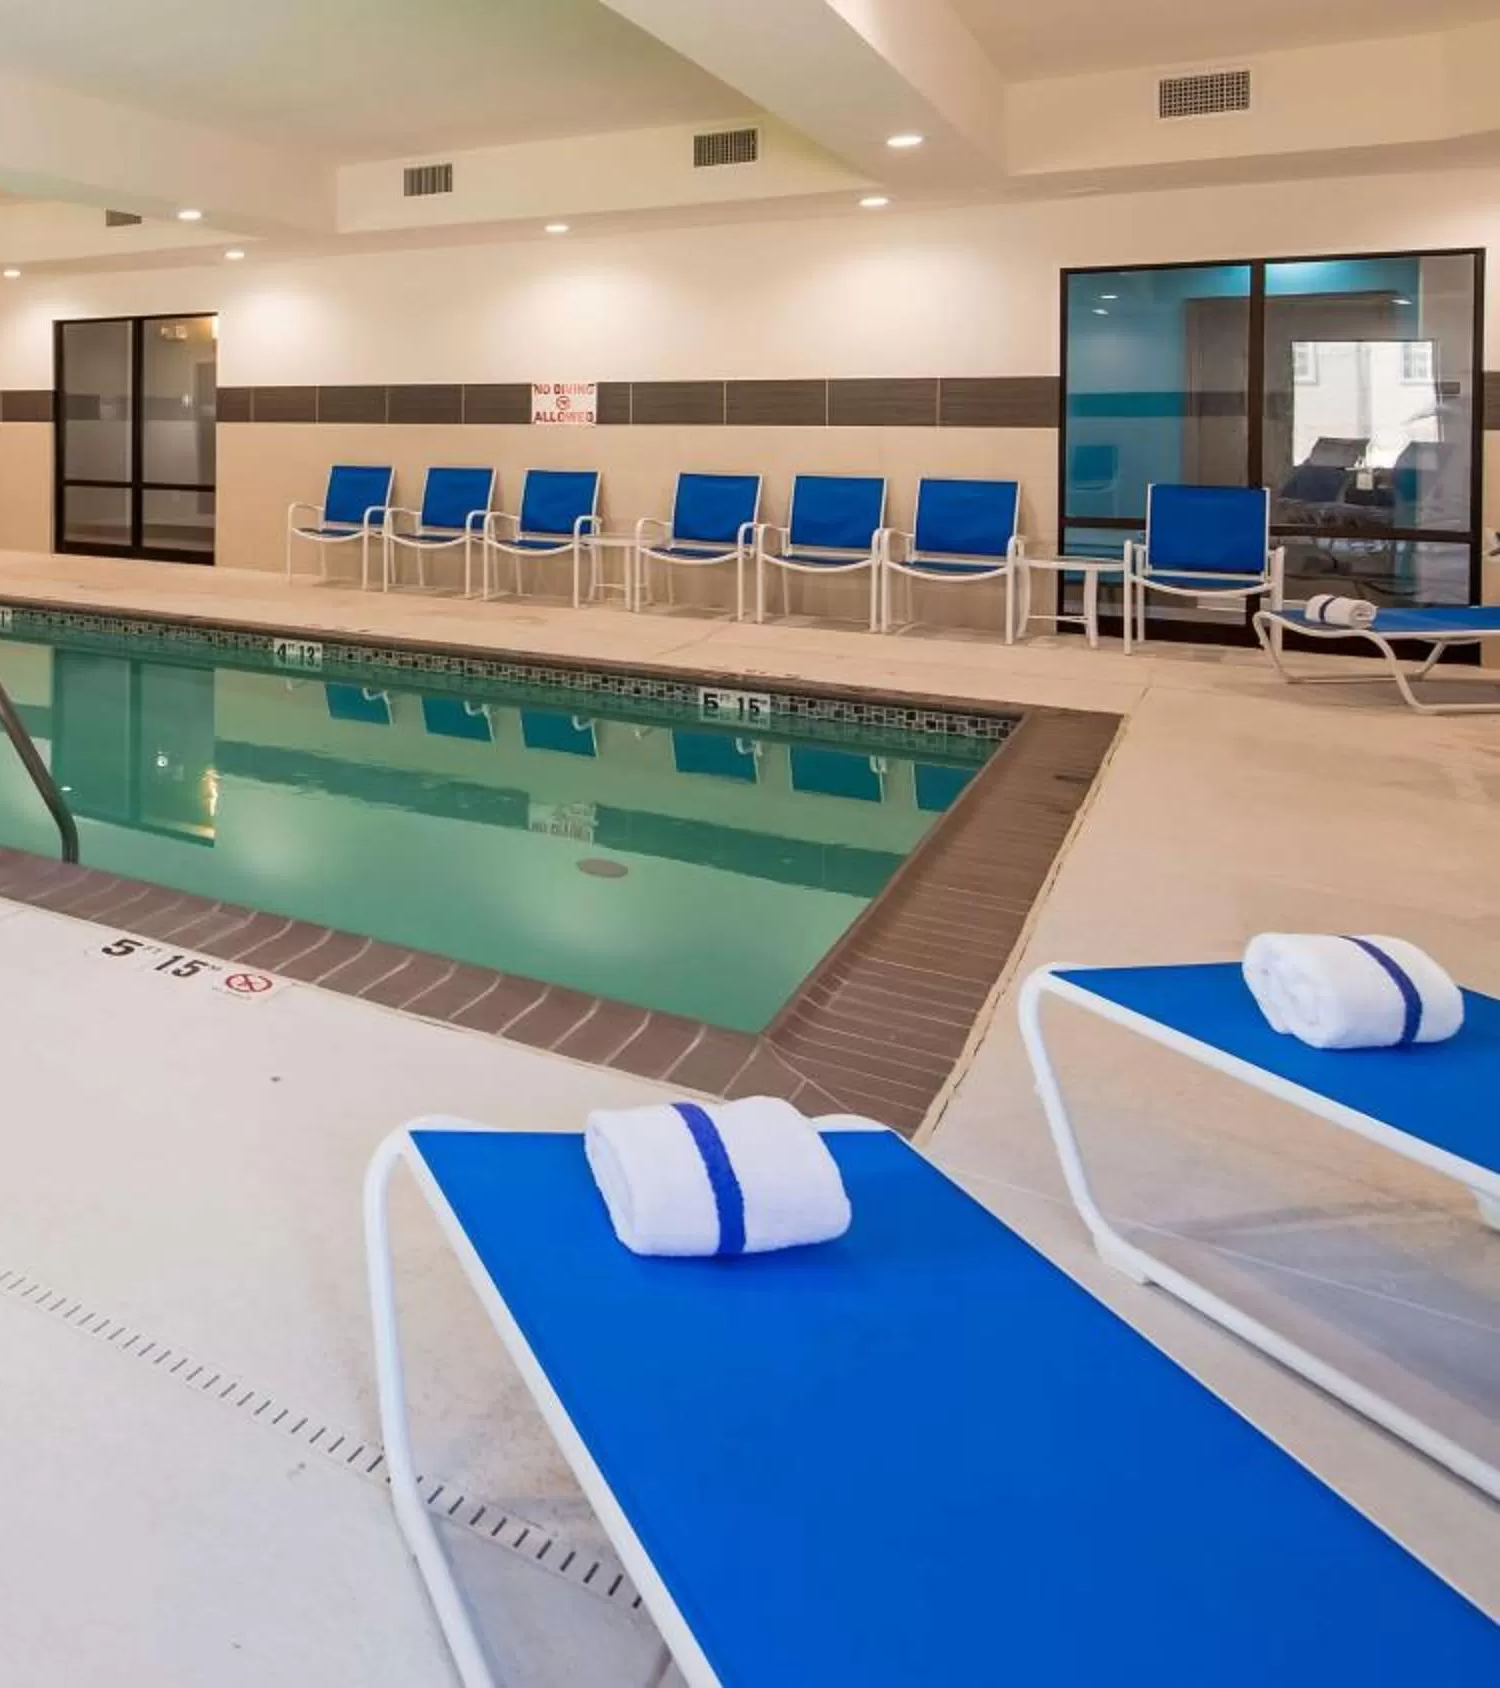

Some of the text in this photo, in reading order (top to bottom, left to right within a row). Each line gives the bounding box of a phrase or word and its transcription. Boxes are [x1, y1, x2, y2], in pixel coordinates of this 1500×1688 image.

[534, 384, 595, 394] NO DIVING
[534, 411, 595, 422] ALLOWED
[101, 938, 145, 957] 5
